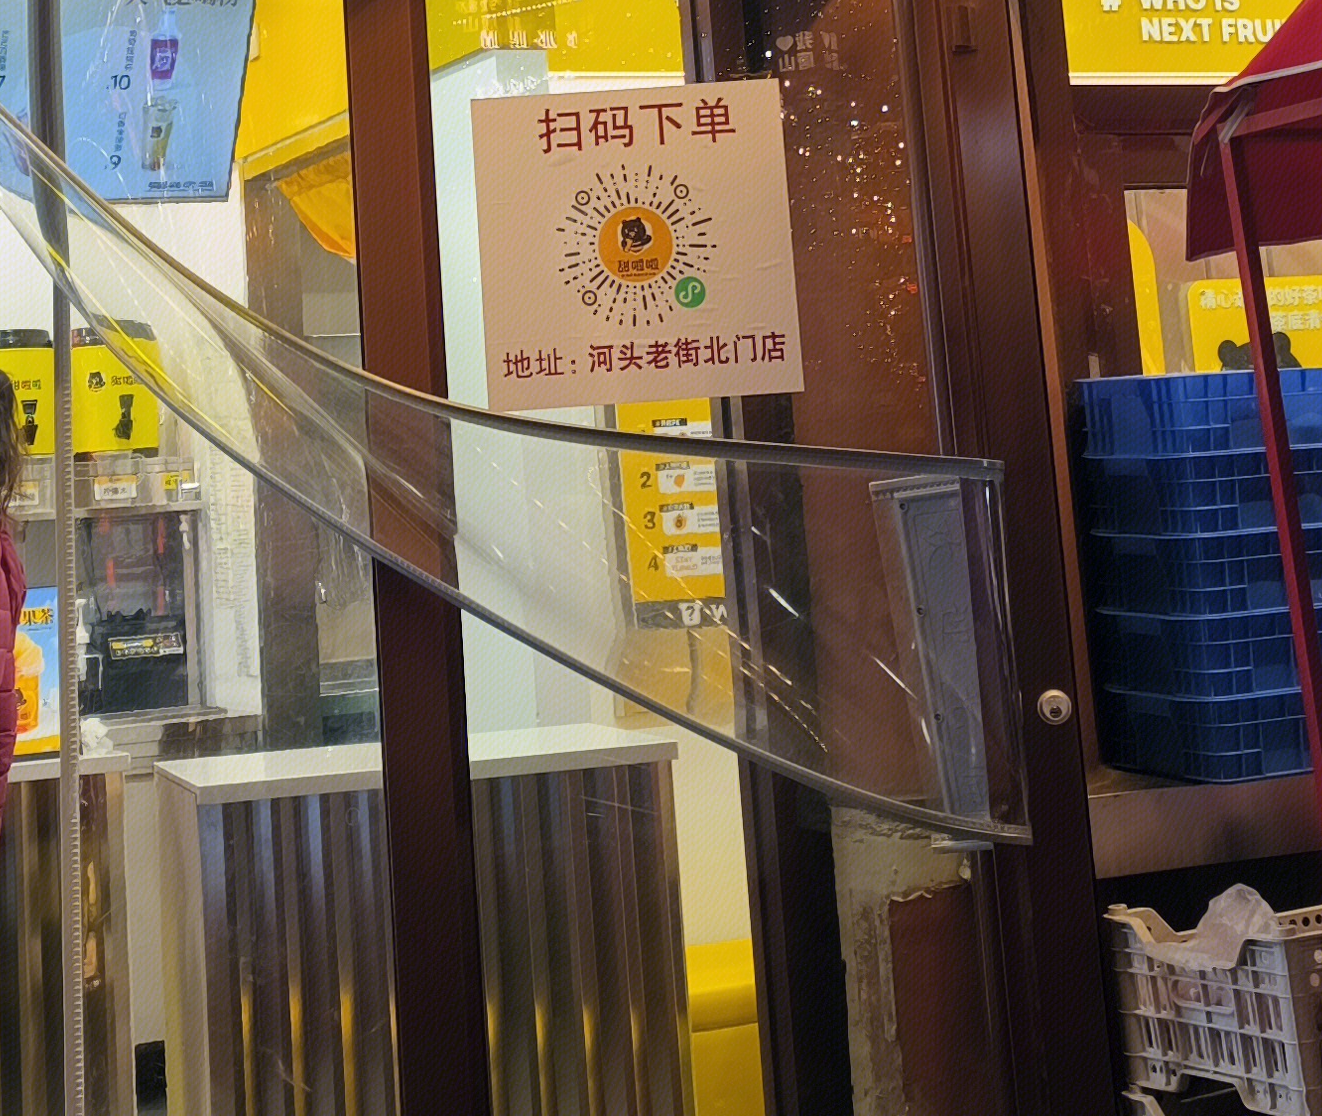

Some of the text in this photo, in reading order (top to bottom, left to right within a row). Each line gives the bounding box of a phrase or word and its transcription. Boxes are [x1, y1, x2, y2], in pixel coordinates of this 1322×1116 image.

[1141, 17, 1213, 43] NEXT
[537, 97, 737, 154] 扫码下单
[639, 471, 652, 490] 2
[643, 511, 656, 530] 3
